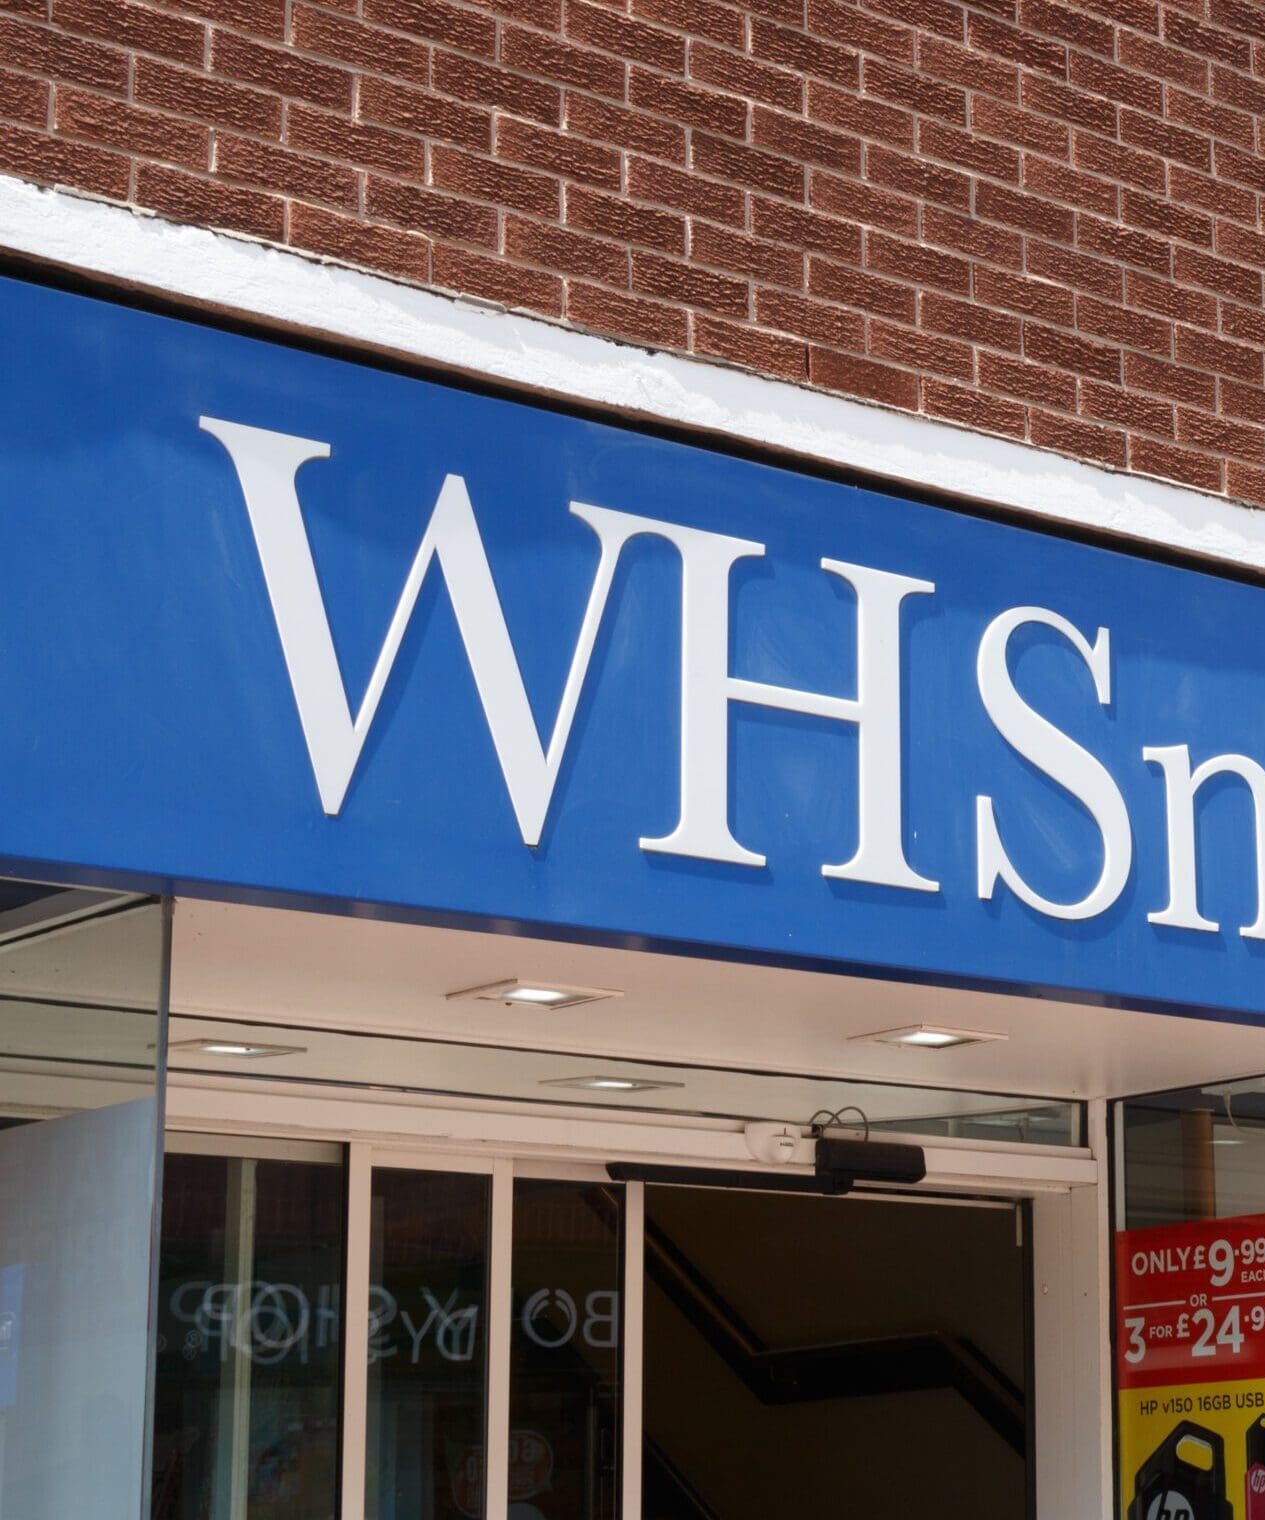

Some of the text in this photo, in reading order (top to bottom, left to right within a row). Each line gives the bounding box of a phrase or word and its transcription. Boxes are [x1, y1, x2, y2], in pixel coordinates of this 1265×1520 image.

[1131, 1246, 1191, 1276] ONLY
[1189, 1294, 1208, 1307] OR
[1124, 1316, 1147, 1364] 3
[1149, 1325, 1173, 1340] FOR
[1140, 1400, 1158, 1415] HP
[1199, 1394, 1231, 1412] 16GB
[1235, 1392, 1264, 1409] USB
[1254, 1471, 1265, 1492] hp
